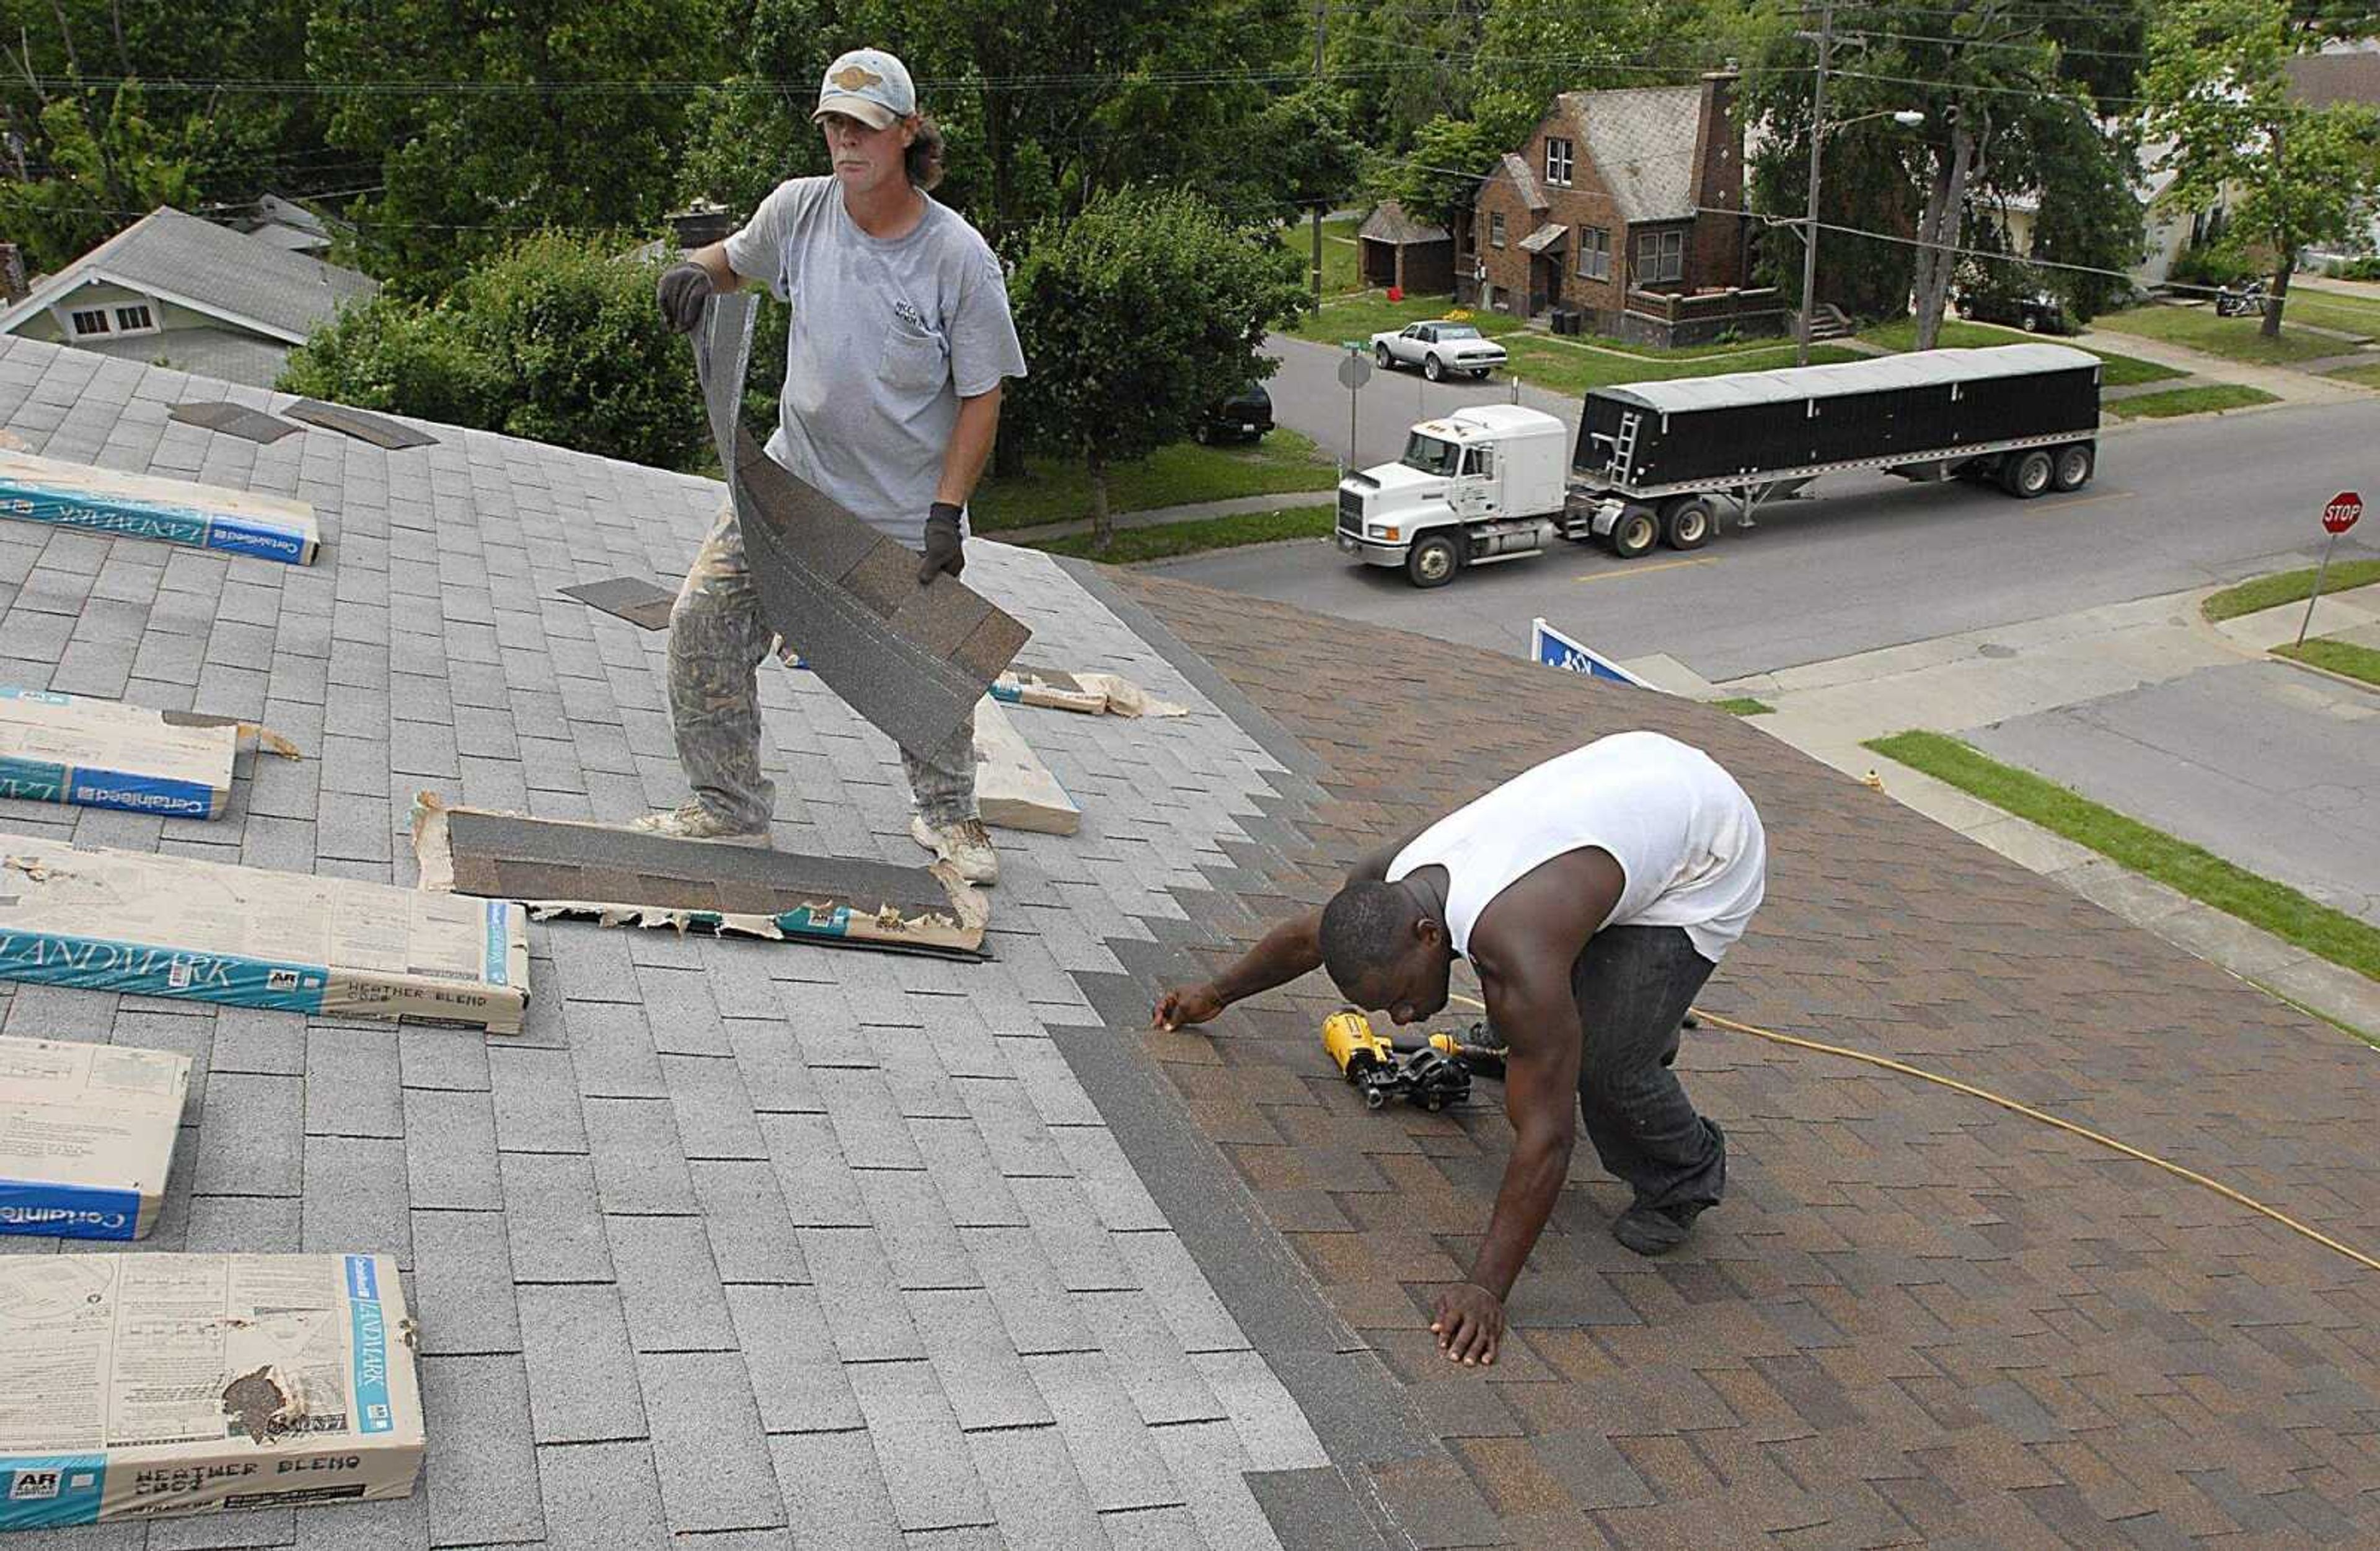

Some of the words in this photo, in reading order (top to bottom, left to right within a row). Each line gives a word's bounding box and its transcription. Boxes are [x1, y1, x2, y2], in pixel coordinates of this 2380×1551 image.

[2325, 504, 2360, 522] STOP
[95, 789, 202, 813] CertainTeed
[359, 1303, 384, 1387] LANDMARK
[19, 1473, 56, 1486] AR
[136, 1462, 258, 1483] HEATHER
